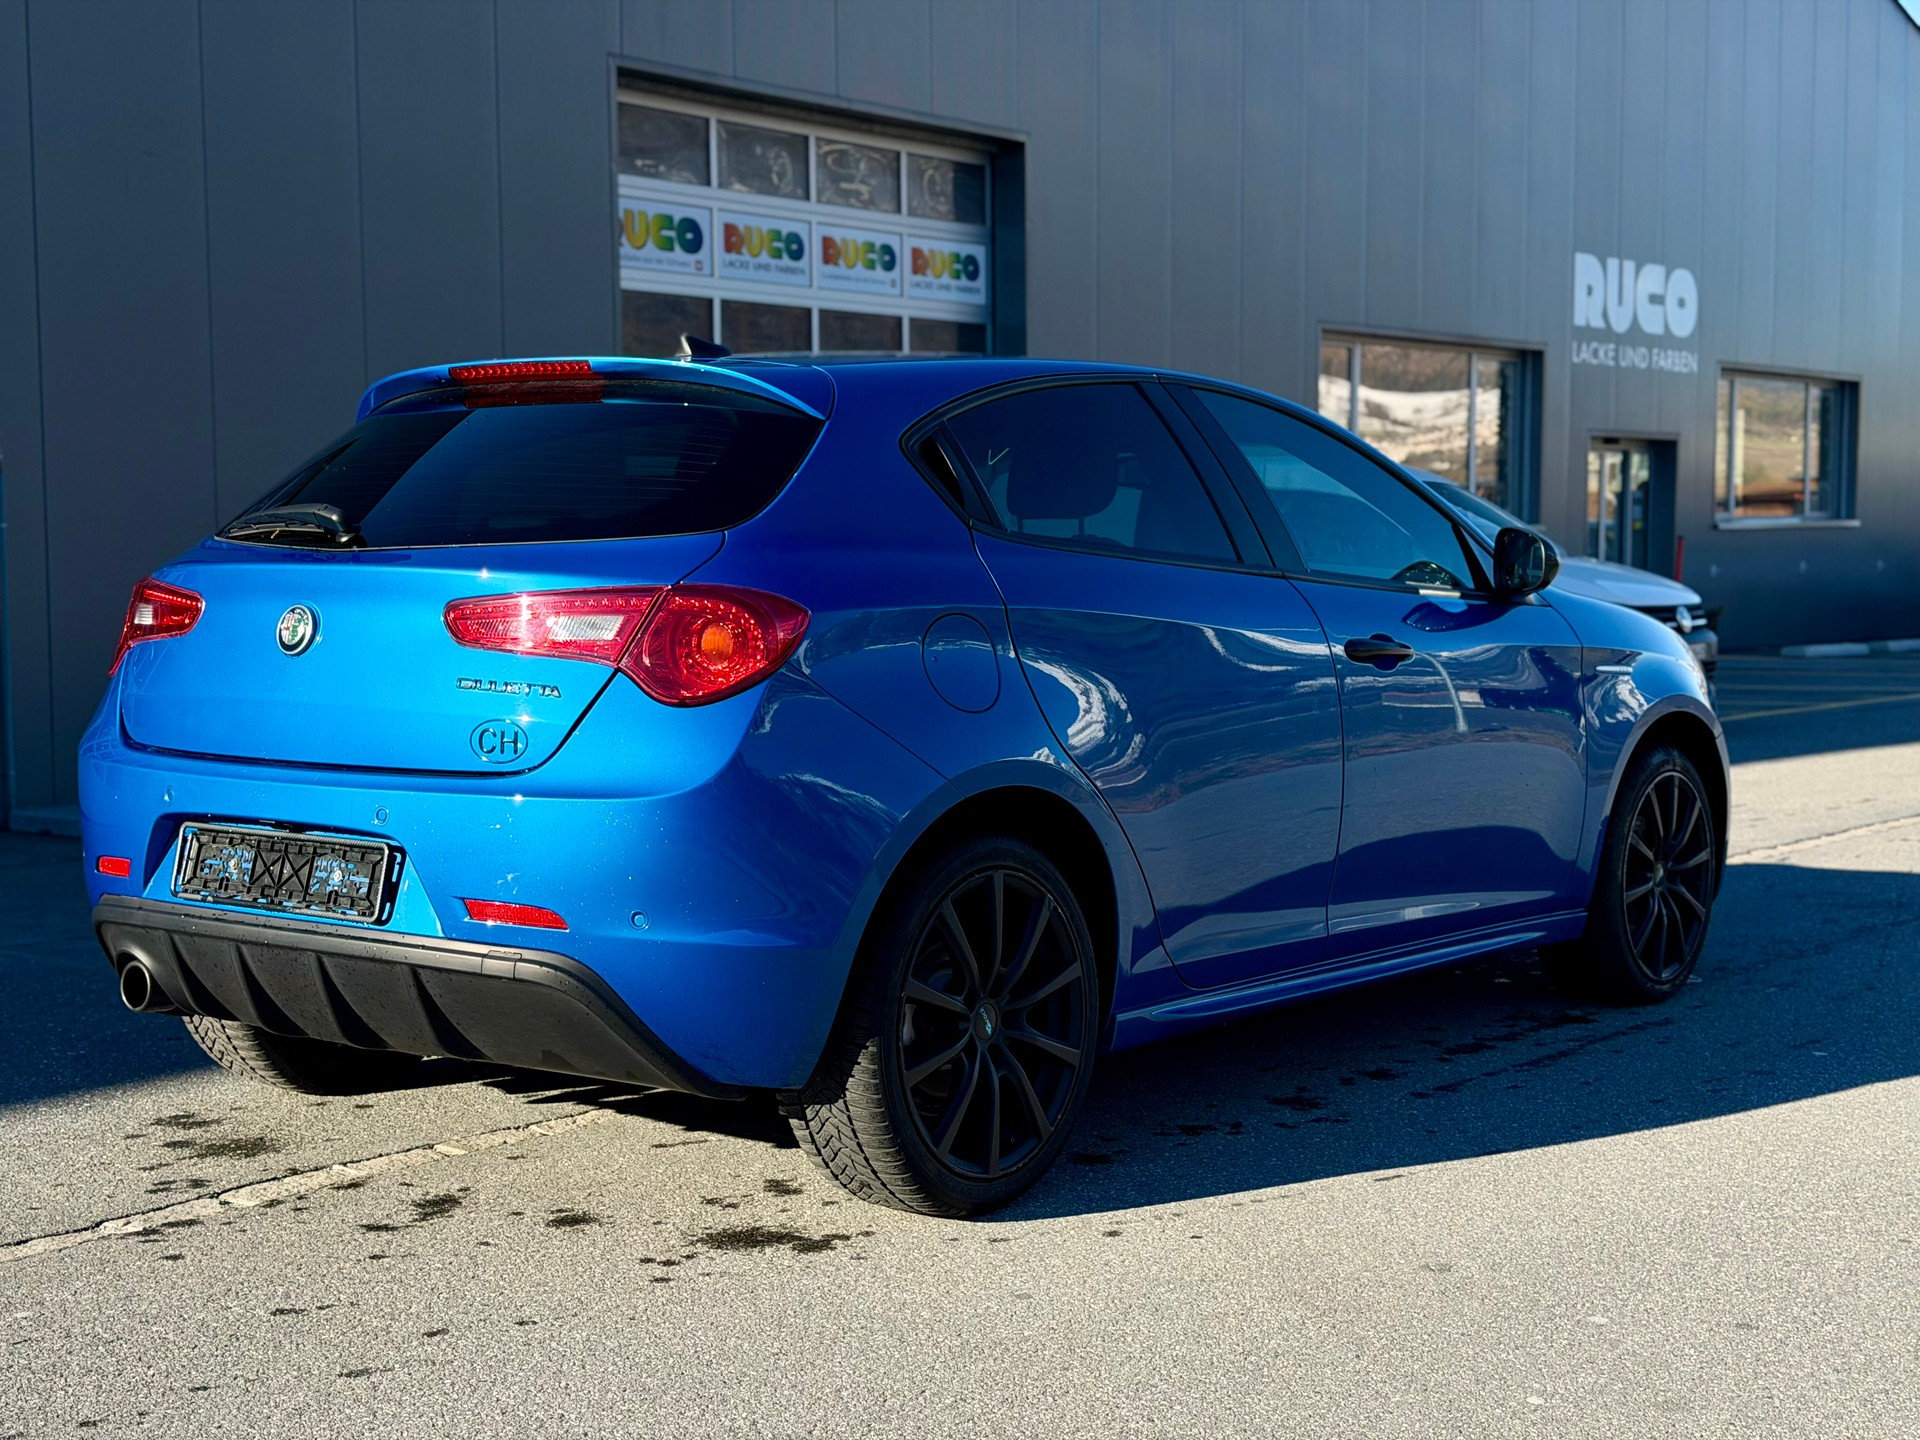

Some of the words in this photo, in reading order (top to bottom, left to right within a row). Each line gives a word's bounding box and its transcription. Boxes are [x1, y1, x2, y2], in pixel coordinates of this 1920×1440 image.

[723, 223, 804, 262] RUCO
[822, 236, 896, 272] RUCO
[911, 247, 980, 282] RUCO
[1573, 251, 1699, 338] RUCO
[1572, 341, 1616, 367] LACKE
[1618, 344, 1650, 370] UND
[1651, 347, 1699, 374] FARBEN
[478, 727, 519, 756] CH
